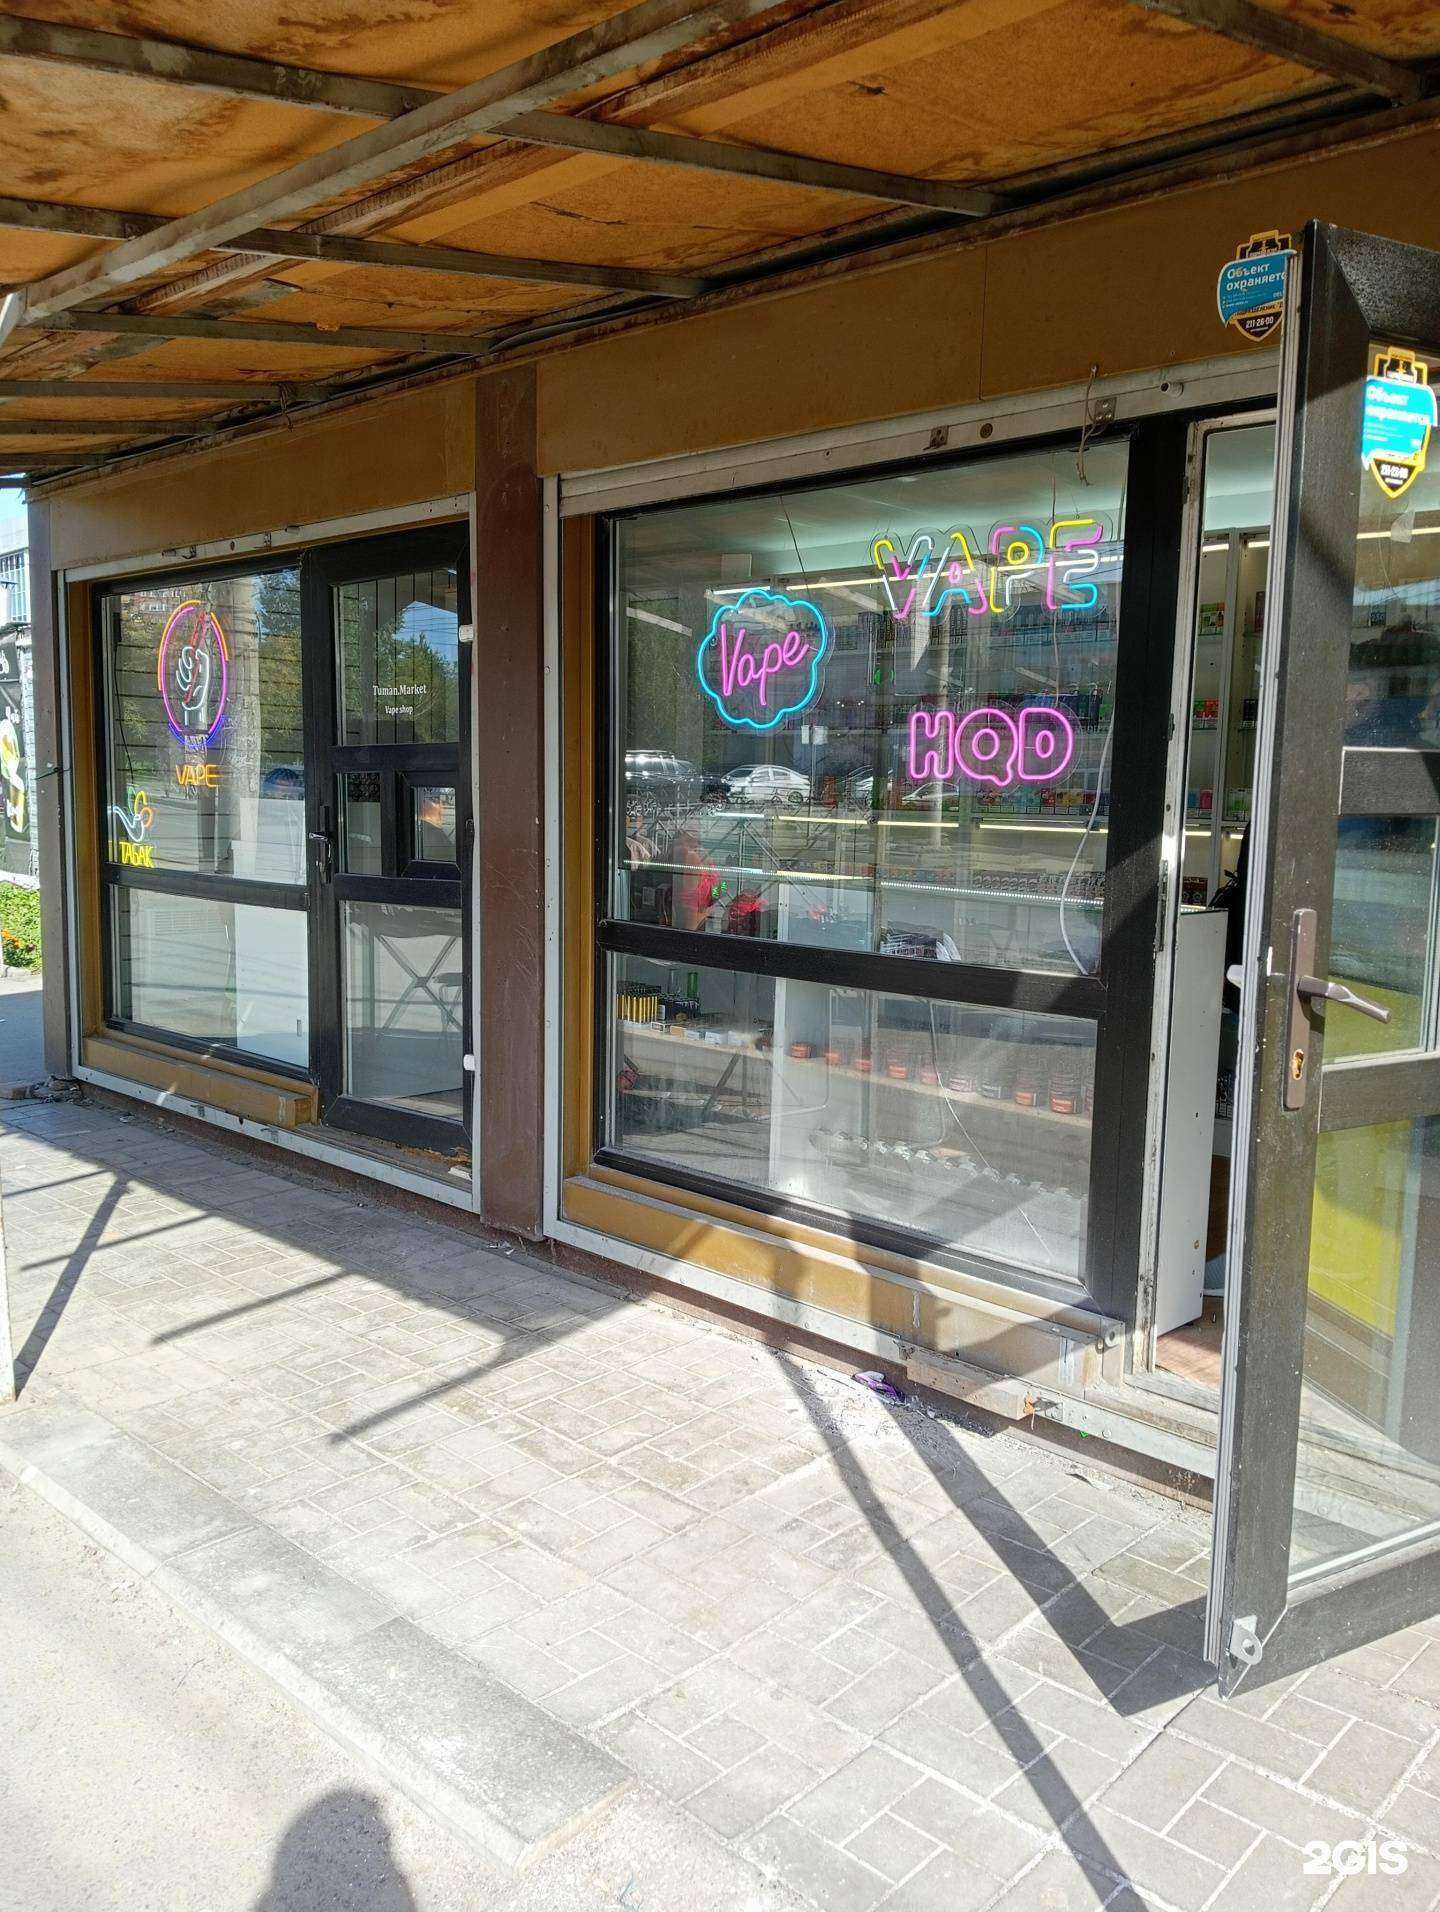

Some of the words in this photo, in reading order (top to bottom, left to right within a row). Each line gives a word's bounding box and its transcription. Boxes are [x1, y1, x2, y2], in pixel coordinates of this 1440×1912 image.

[1226, 271, 1288, 292] охраняетс
[1227, 263, 1270, 280] Объект
[873, 519, 1103, 619] VAPE
[720, 624, 810, 706] Vape
[372, 683, 427, 696] Tuman.Market
[385, 705, 398, 716] Vape
[400, 704, 414, 715] shop
[909, 707, 1074, 787] HQD
[175, 764, 223, 788] VAPE
